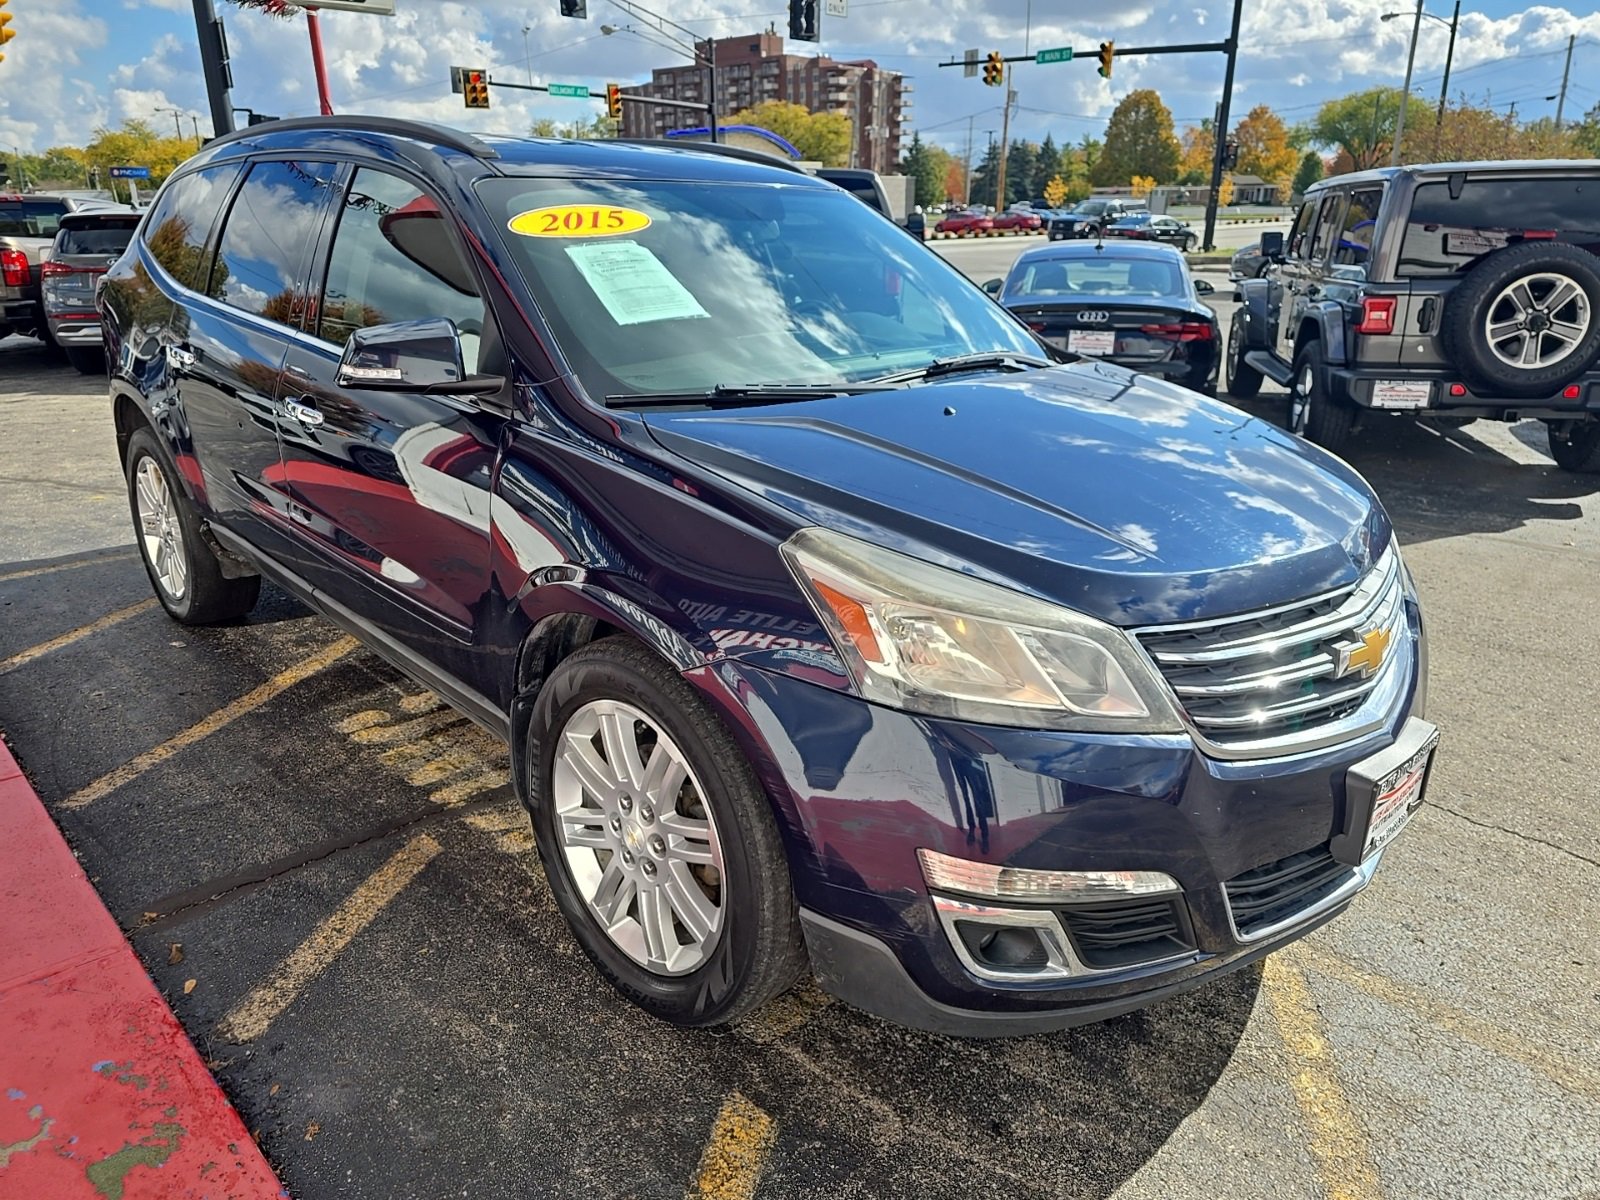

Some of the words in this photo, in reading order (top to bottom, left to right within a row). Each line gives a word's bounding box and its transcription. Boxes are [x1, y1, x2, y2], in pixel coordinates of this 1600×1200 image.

[829, 3, 845, 14] ONLY
[1044, 51, 1061, 62] MAIN
[1062, 49, 1071, 60] ST
[549, 86, 575, 96] BELMONT
[541, 210, 624, 232] 2015
